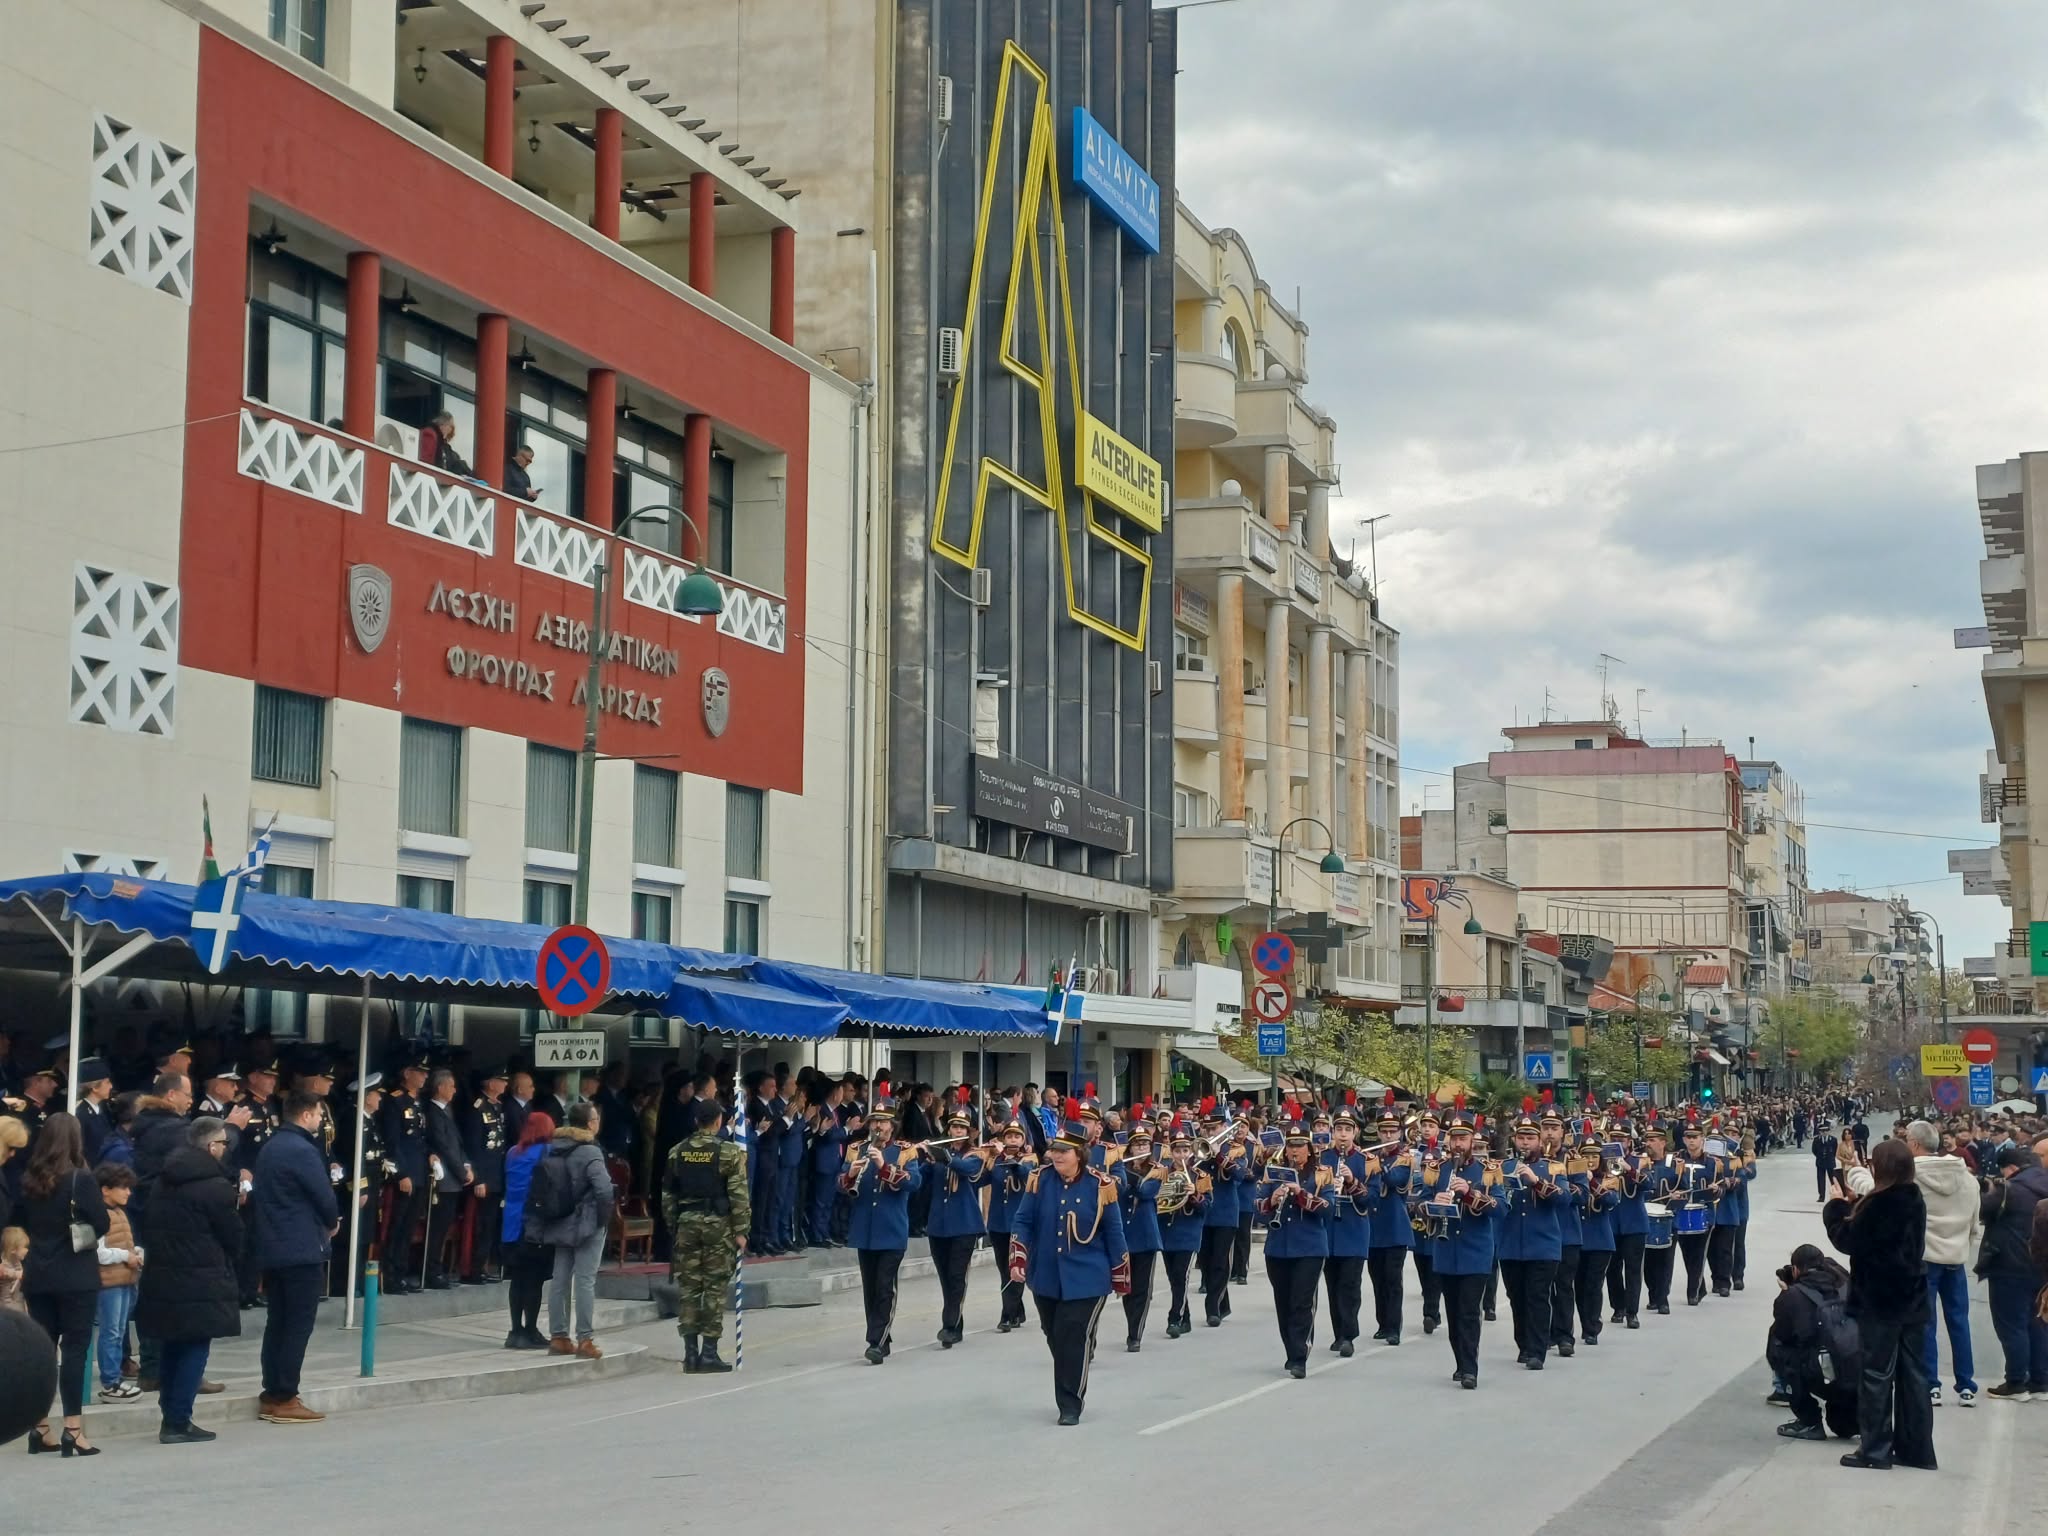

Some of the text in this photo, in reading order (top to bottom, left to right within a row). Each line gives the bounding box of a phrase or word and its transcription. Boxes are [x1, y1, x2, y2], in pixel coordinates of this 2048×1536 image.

[1086, 124, 1157, 220] ALIAVITA
[1091, 430, 1156, 500] ALTERLIFE
[1091, 467, 1156, 518] FITNESS EXCELLENCE
[427, 580, 516, 633] ΛΕΣΧΗ
[446, 644, 556, 702] ΦΡΟΥΡΑΣ
[550, 1048, 599, 1060] ΛΑΦΛ
[1262, 1038, 1282, 1046] ΤΑΞΙ
[1942, 1048, 1963, 1056] HOT
